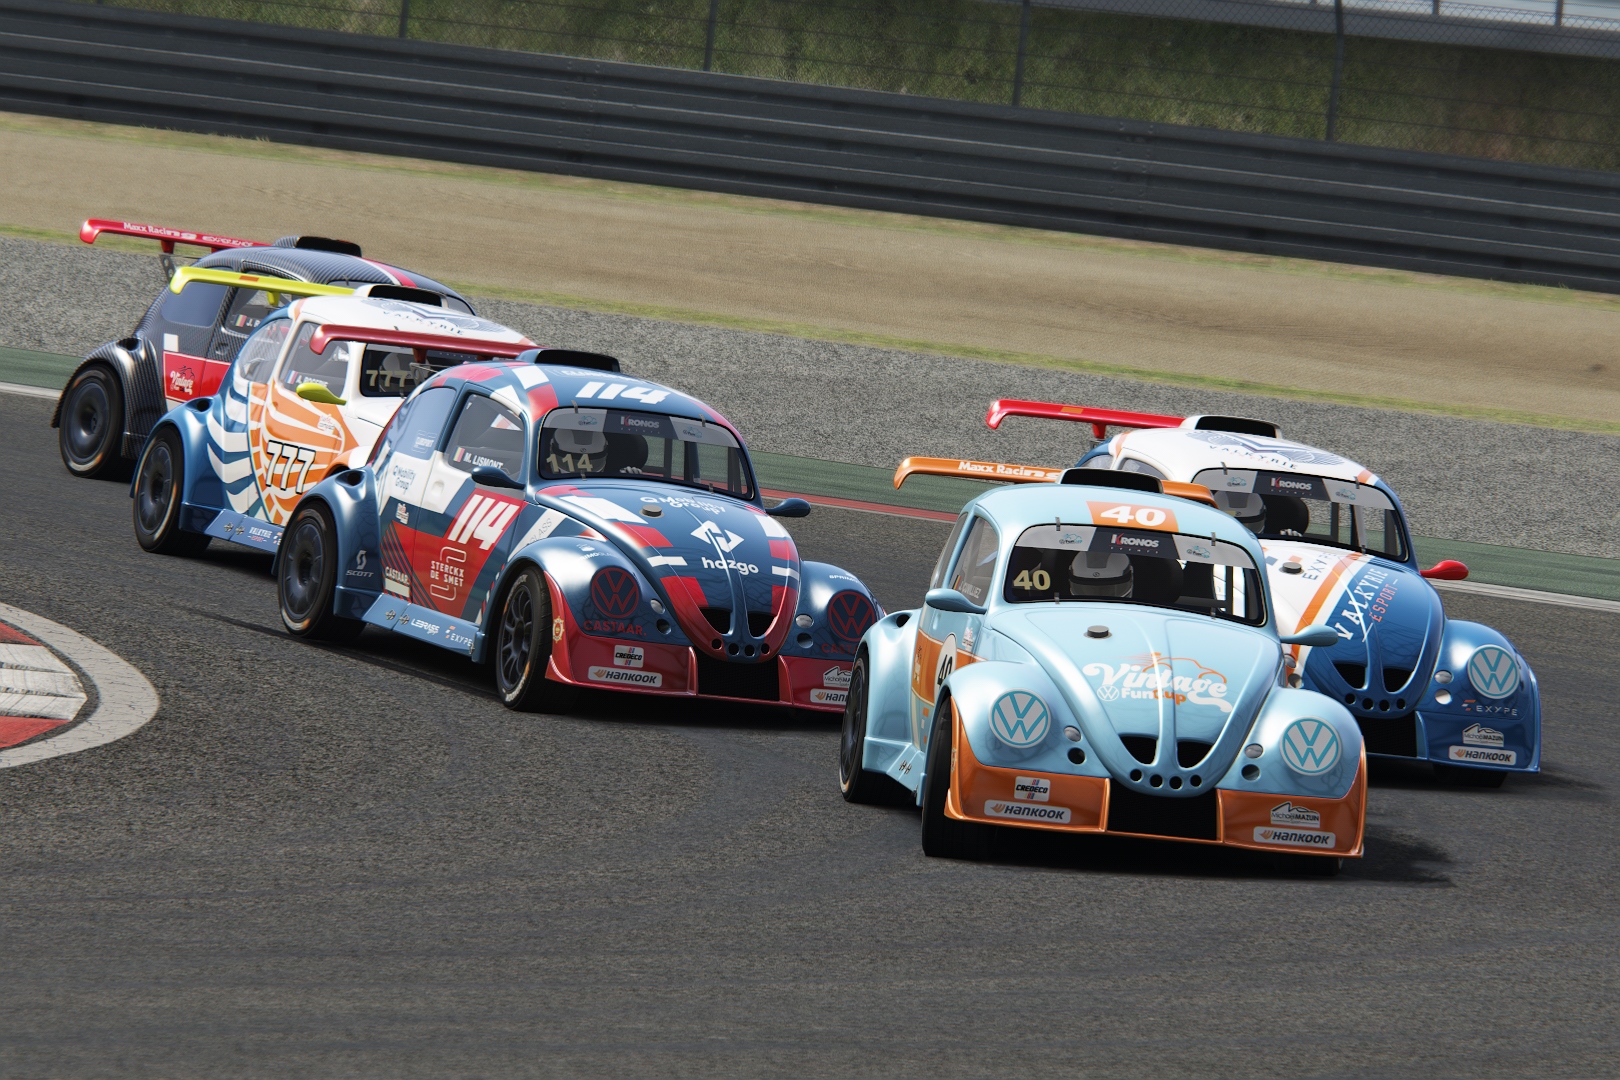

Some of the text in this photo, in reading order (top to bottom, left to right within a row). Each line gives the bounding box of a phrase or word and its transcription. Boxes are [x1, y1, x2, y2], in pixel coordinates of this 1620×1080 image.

[123, 222, 147, 232] Maxx
[148, 225, 197, 240] Racing
[366, 370, 408, 388] 777
[575, 381, 671, 404] 114
[620, 415, 660, 428] KRONOS
[546, 453, 593, 474] 114
[1209, 445, 1298, 470] VALKYRIE
[266, 440, 316, 494] 777
[958, 461, 994, 473] Maxx
[1270, 476, 1312, 490] KRONOS
[447, 494, 520, 551] 114
[1100, 505, 1166, 526] 40
[1111, 532, 1160, 548] KRONOS
[430, 561, 464, 578] STERCKX
[701, 557, 759, 576] hazgo
[430, 570, 464, 587] DE SMET
[1013, 570, 1051, 590] 40
[1334, 568, 1388, 640] VALKYRIE
[1369, 584, 1398, 622] ESPORT
[450, 633, 474, 647] EXYPE
[615, 652, 642, 660] CREDECO
[1082, 662, 1233, 713] Vintage
[1122, 687, 1186, 706] FunCup
[1476, 705, 1518, 716] EXYPE
[1016, 784, 1048, 794] CREDECO
